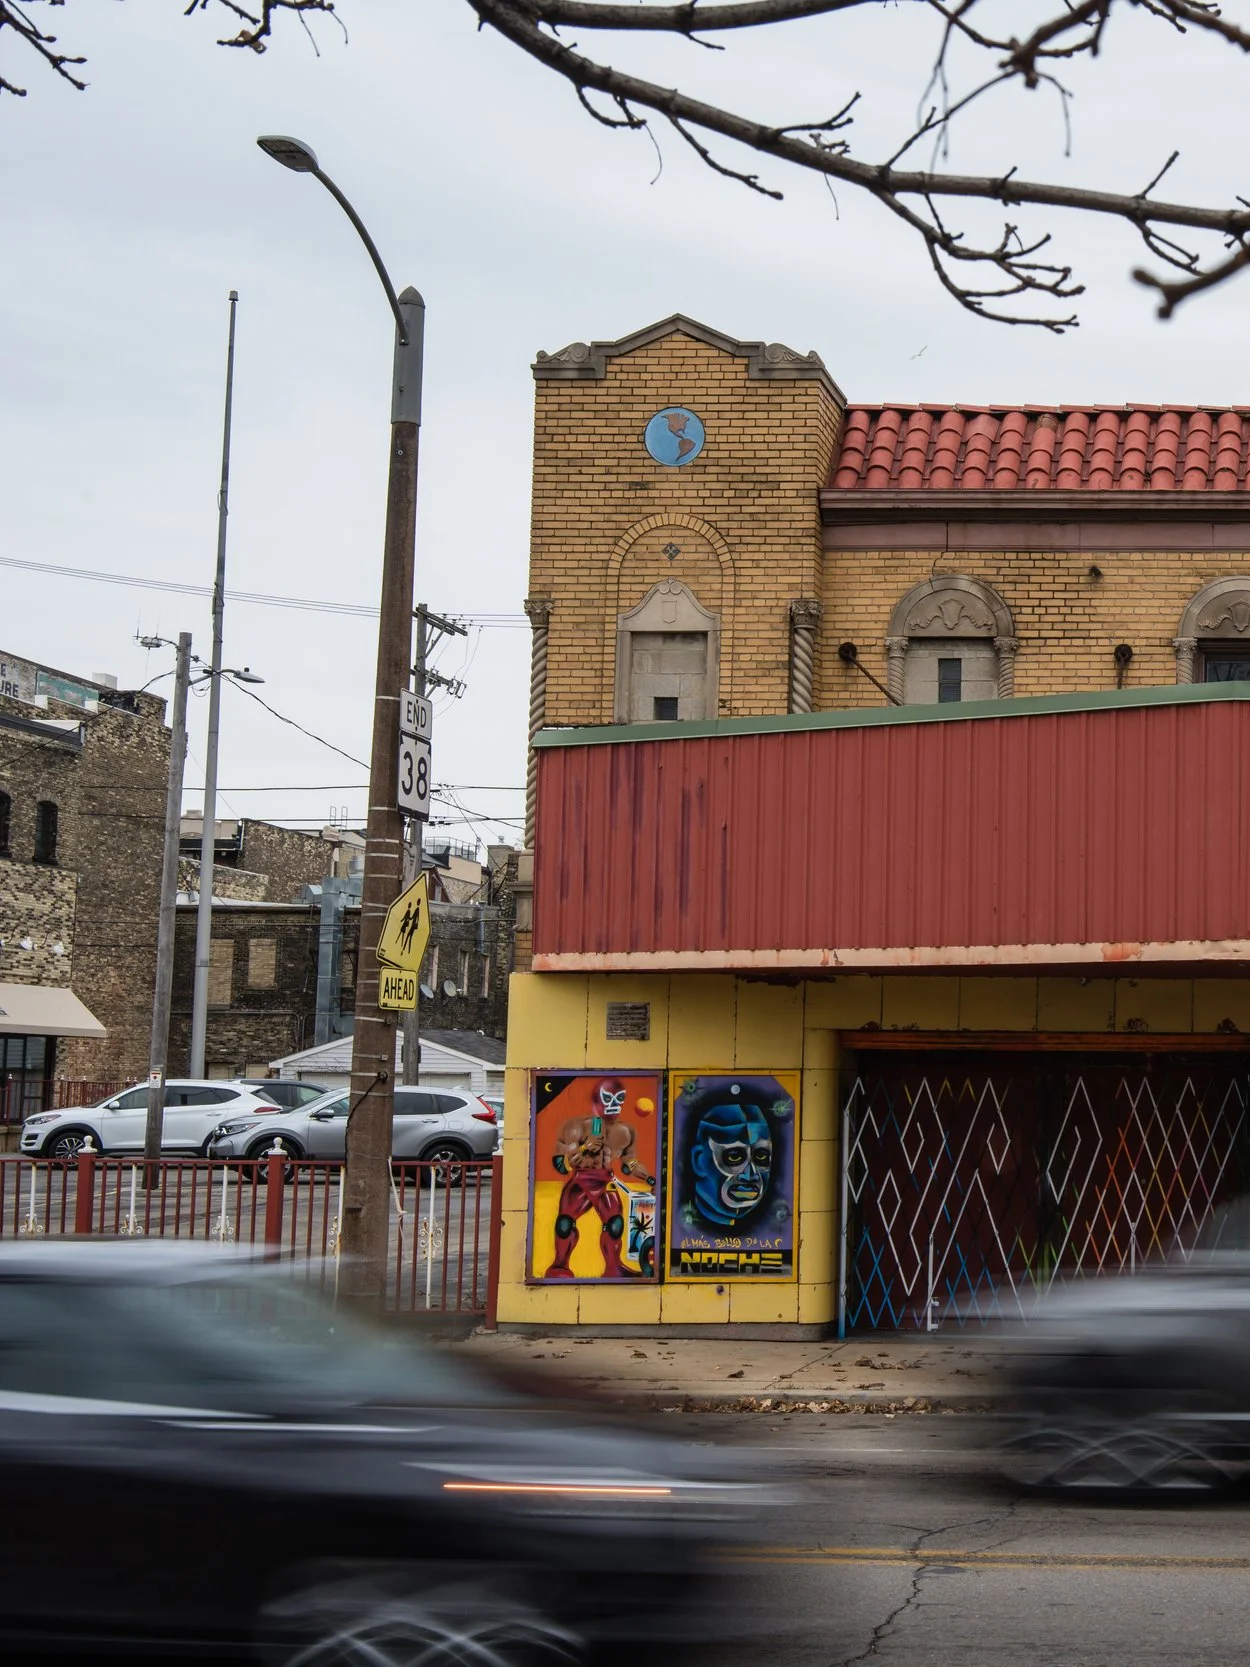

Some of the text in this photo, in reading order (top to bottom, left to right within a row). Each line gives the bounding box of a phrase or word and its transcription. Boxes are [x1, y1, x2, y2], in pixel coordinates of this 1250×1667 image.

[407, 700, 427, 728] END
[401, 751, 428, 800] 38
[383, 977, 415, 1001] AHEAD
[680, 1238, 691, 1249] EL
[760, 1239, 772, 1249] LA
[681, 1252, 783, 1274] NOCHE
